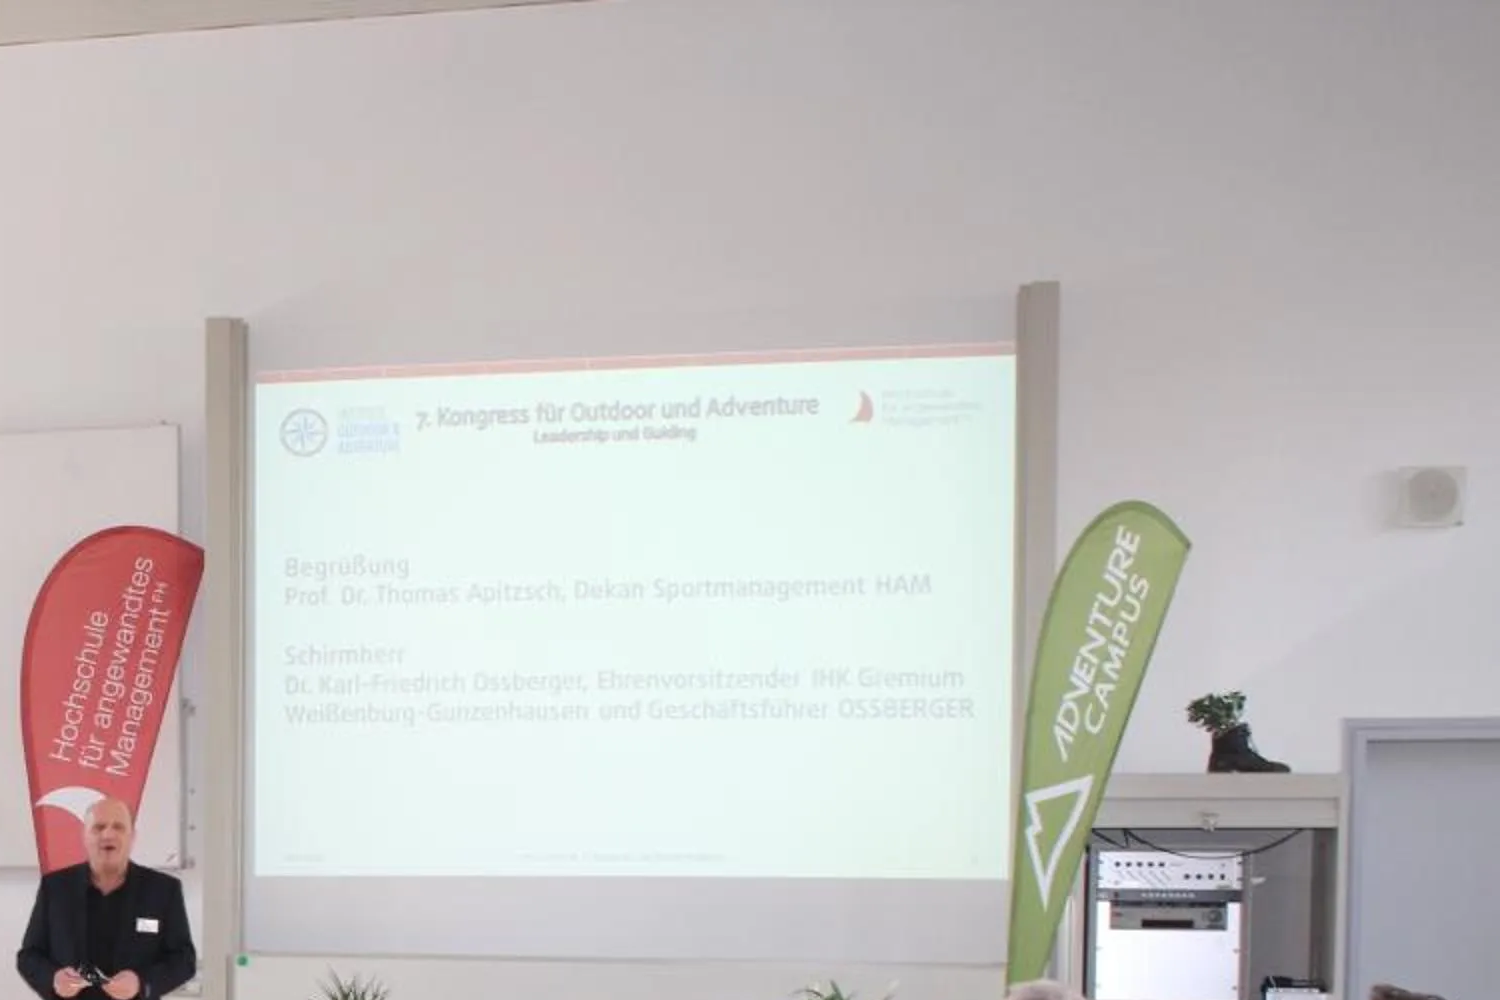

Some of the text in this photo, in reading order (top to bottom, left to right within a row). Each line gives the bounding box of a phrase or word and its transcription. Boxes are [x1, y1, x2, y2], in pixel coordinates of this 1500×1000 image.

[415, 411, 433, 432] 7.
[437, 405, 531, 432] Kongress
[534, 402, 566, 424] für
[569, 399, 657, 423] Outdoor
[660, 396, 702, 420] und
[705, 394, 821, 418] Adventure
[613, 427, 639, 441] und
[283, 553, 411, 581] Begrüßung
[341, 582, 368, 606] Dr.
[374, 580, 461, 605] Thomas
[465, 579, 568, 605] Apitzsch,
[573, 577, 646, 601] Dekan
[652, 576, 867, 604] Sportmanagement
[874, 572, 933, 596] HAM
[283, 643, 407, 667] Schirmherr
[1053, 525, 1141, 763] ADVENTURE
[1084, 573, 1150, 735] CAMPUS
[79, 556, 154, 769] für angewandtes
[284, 664, 966, 696] Dr. Karl-Friedrich Ossberger, Ehrenvorsitzender IHK Gremium
[49, 610, 109, 762] Hochschule
[106, 608, 172, 777] Management
[283, 695, 976, 728] Weißenburg-Gunzenhausen und Geschäftsführer OSSBERGER
